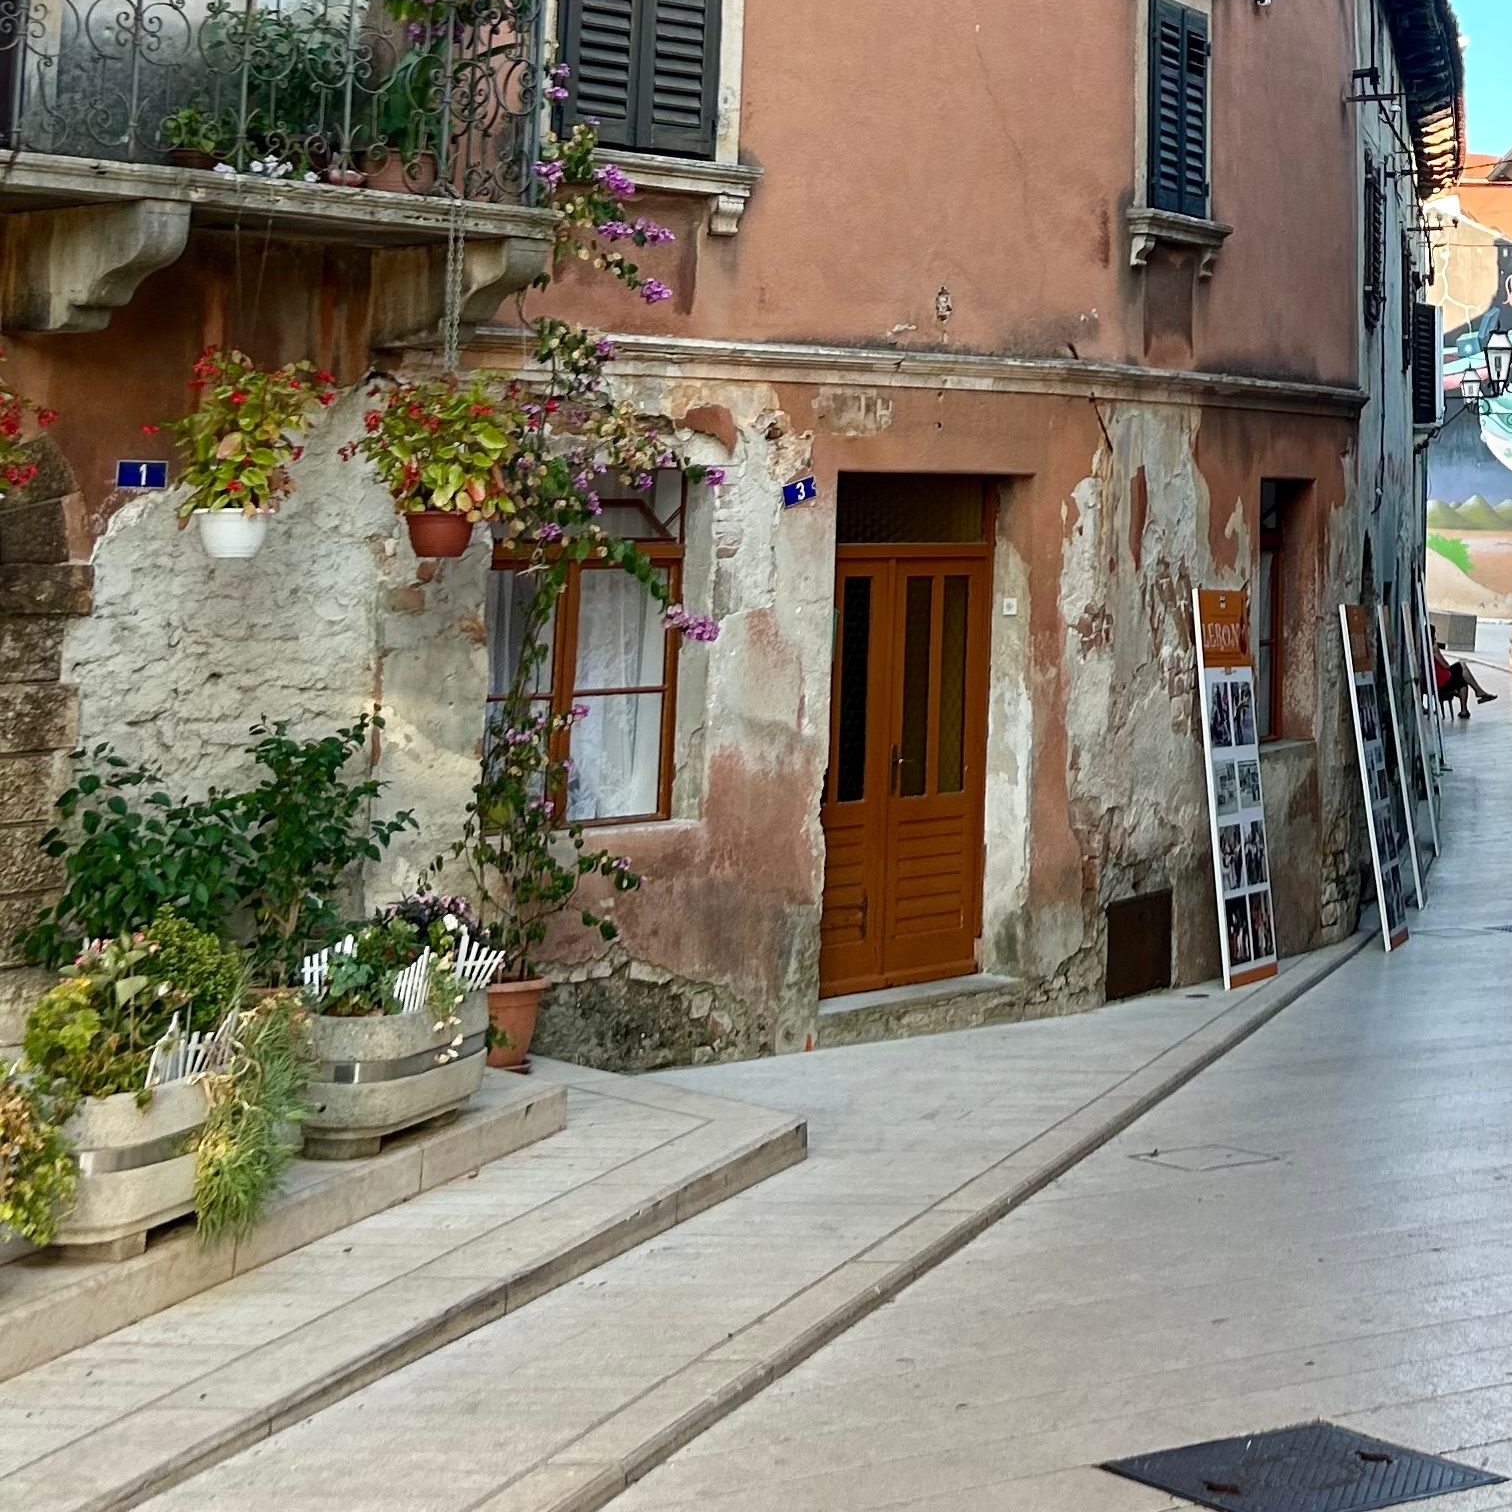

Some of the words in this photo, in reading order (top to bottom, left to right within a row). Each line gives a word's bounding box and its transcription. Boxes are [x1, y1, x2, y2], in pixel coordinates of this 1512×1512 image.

[139, 463, 148, 486] 1
[795, 481, 806, 500] 3
[1202, 622, 1240, 652] LERON
